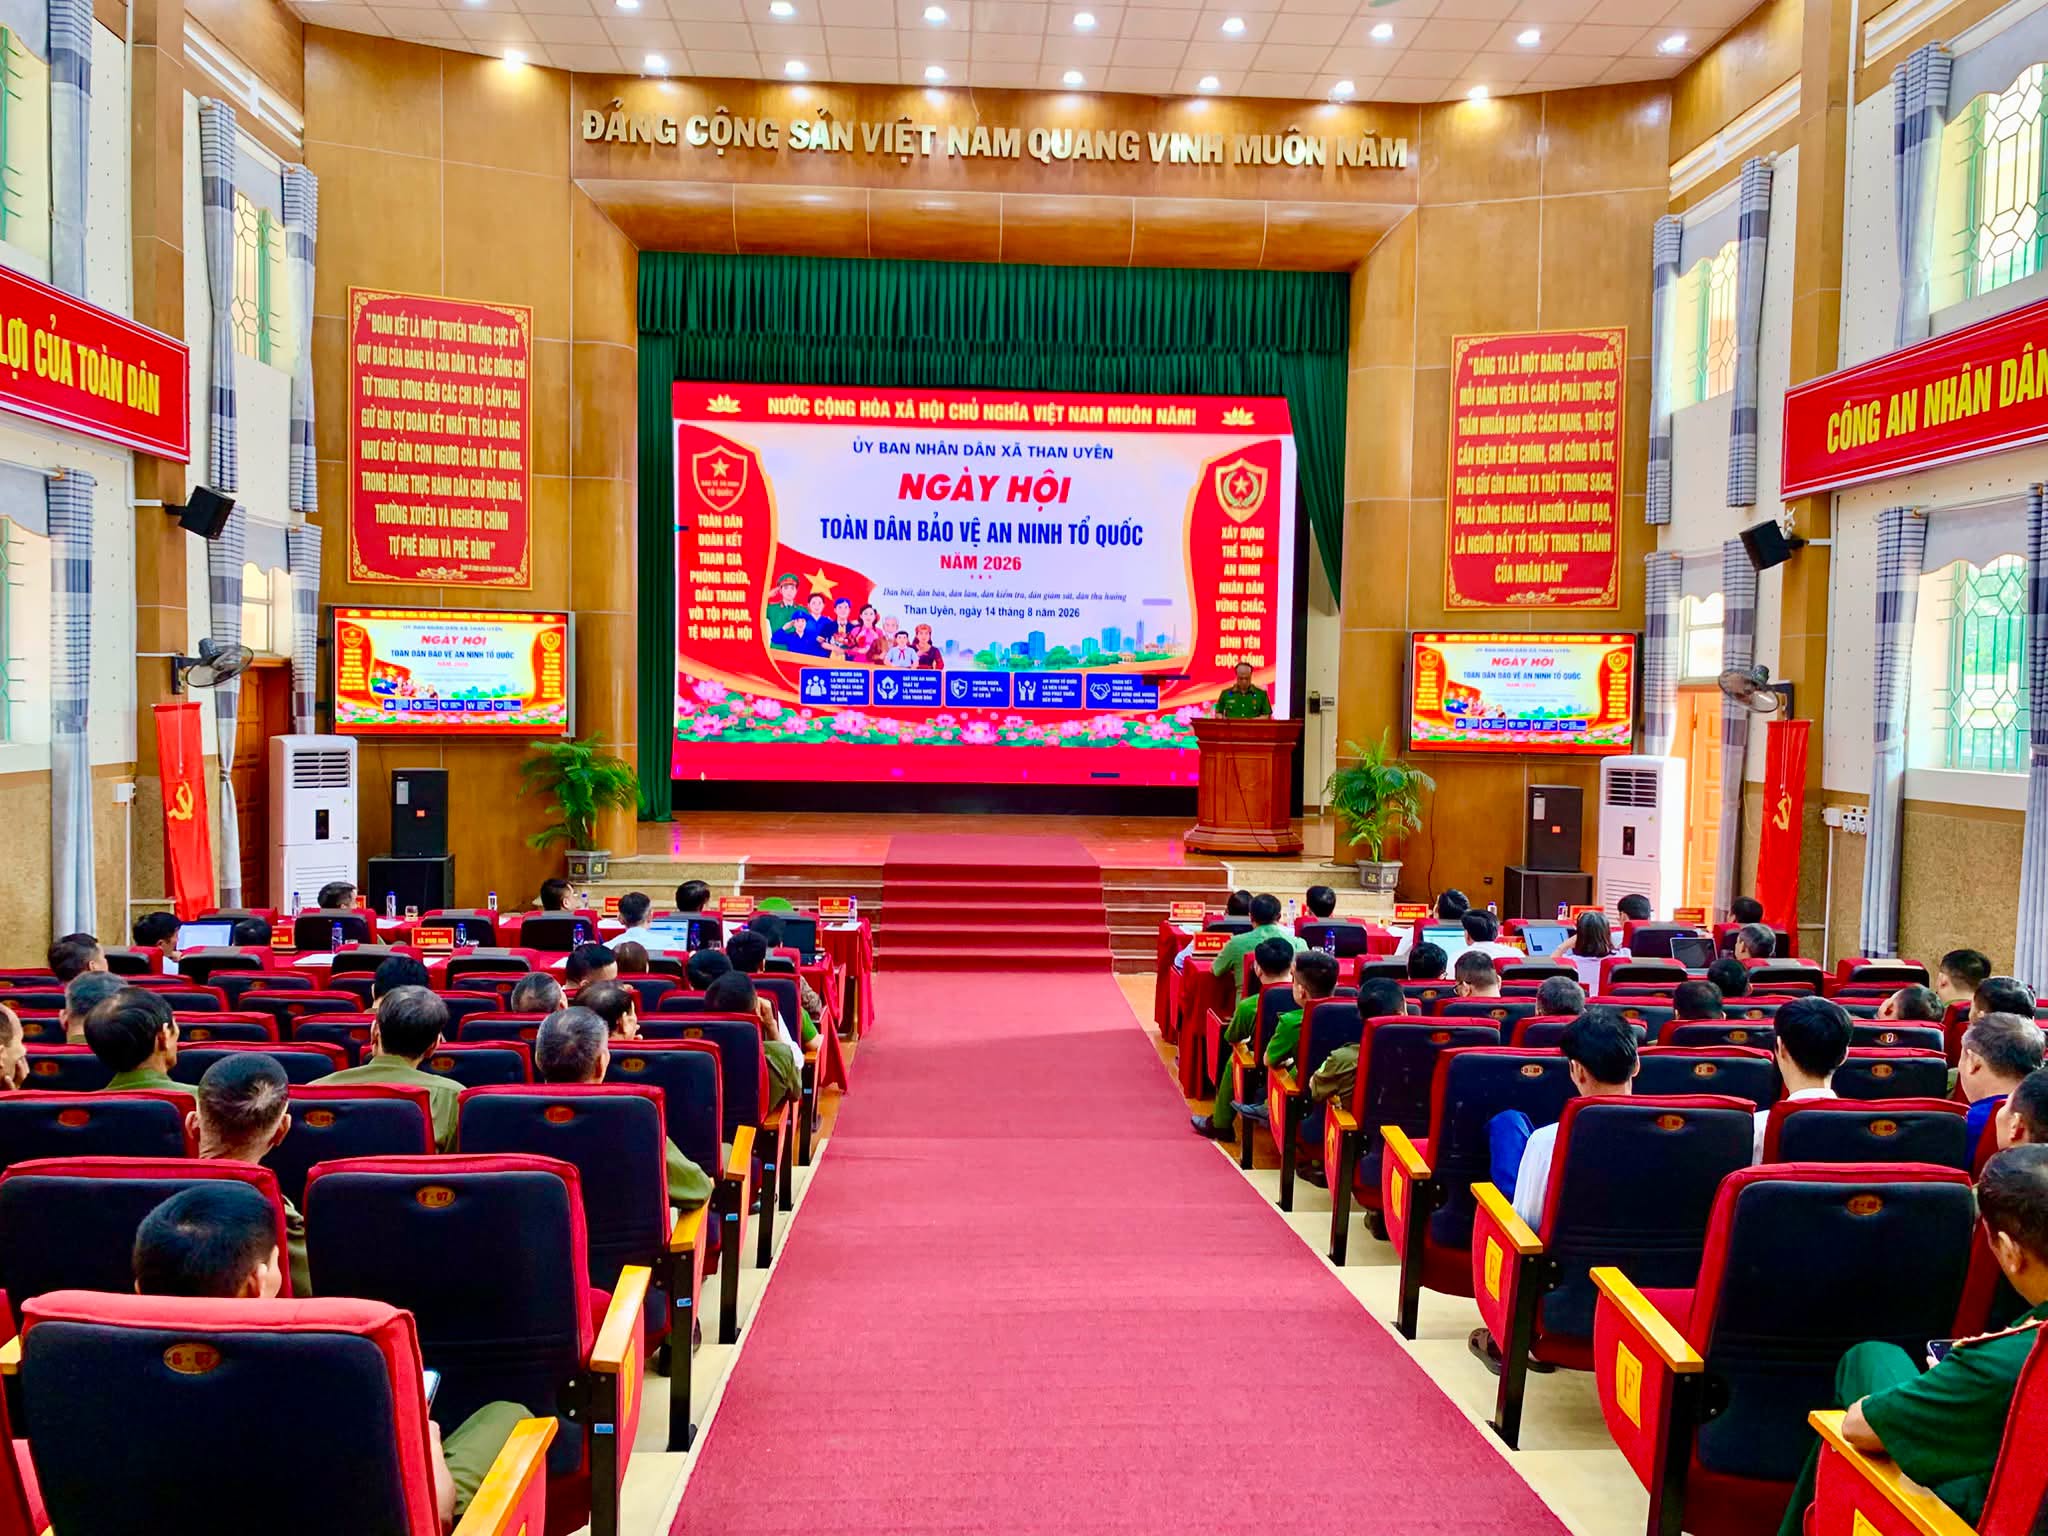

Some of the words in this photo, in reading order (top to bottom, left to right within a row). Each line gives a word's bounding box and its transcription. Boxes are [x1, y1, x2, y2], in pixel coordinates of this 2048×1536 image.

[582, 97, 677, 145] ĐẢNG
[685, 105, 779, 156] CỘNG
[787, 106, 854, 152] SẢN
[861, 116, 937, 164] VIỆT
[947, 119, 1021, 158] NAM
[1027, 127, 1140, 164] QUANG
[1148, 132, 1224, 164] VINH
[1234, 125, 1326, 166] MUÔN
[1336, 128, 1408, 168] NĂM
[34, 313, 73, 387] CỦA
[76, 343, 123, 404] TOÀN
[127, 359, 160, 416] DÂN
[767, 393, 811, 416] NƯỚC
[814, 396, 856, 420] CỘNG
[859, 397, 891, 418] HÒA
[894, 398, 916, 419] XÃ
[919, 399, 945, 424] HỘI
[948, 397, 979, 421] CHỦ
[983, 401, 1029, 421] NGHĨA
[1033, 402, 1064, 426] VIỆT
[1068, 405, 1104, 424] NAM
[1107, 404, 1152, 425] MUÔN
[1156, 405, 1197, 426] NĂM!
[1827, 399, 1881, 454] CÔNG
[1885, 388, 1918, 439] AN
[1923, 362, 1993, 429] NHÂN
[1999, 342, 2048, 408] DÂN
[853, 435, 874, 454] ỦY
[879, 442, 911, 455] BAN
[915, 441, 958, 457] NHÂN
[963, 441, 996, 458] DÂN
[1001, 442, 1022, 458] XÃ
[1027, 445, 1067, 459] THAN
[1073, 443, 1113, 460] UYÊN
[898, 466, 1000, 501] NGÀY
[1006, 468, 1071, 512] HỘI
[820, 513, 868, 540] TOÀN
[874, 515, 911, 541] DÂN
[918, 512, 953, 542] BẢO
[960, 517, 981, 547] VỆ
[987, 522, 1012, 543] AN
[1018, 522, 1063, 545] NINH
[1068, 515, 1090, 545] TỔ
[1095, 517, 1144, 547] QUỐC
[940, 553, 978, 570] NĂM
[983, 556, 1022, 571] 2026
[904, 604, 927, 615] Than
[930, 605, 957, 617] Uyên,
[959, 606, 982, 618] ngày
[985, 607, 996, 617] 14
[998, 606, 1025, 619] tháng
[1027, 608, 1033, 617] 8
[1036, 608, 1056, 618] năm
[1058, 608, 1080, 618] 2026
